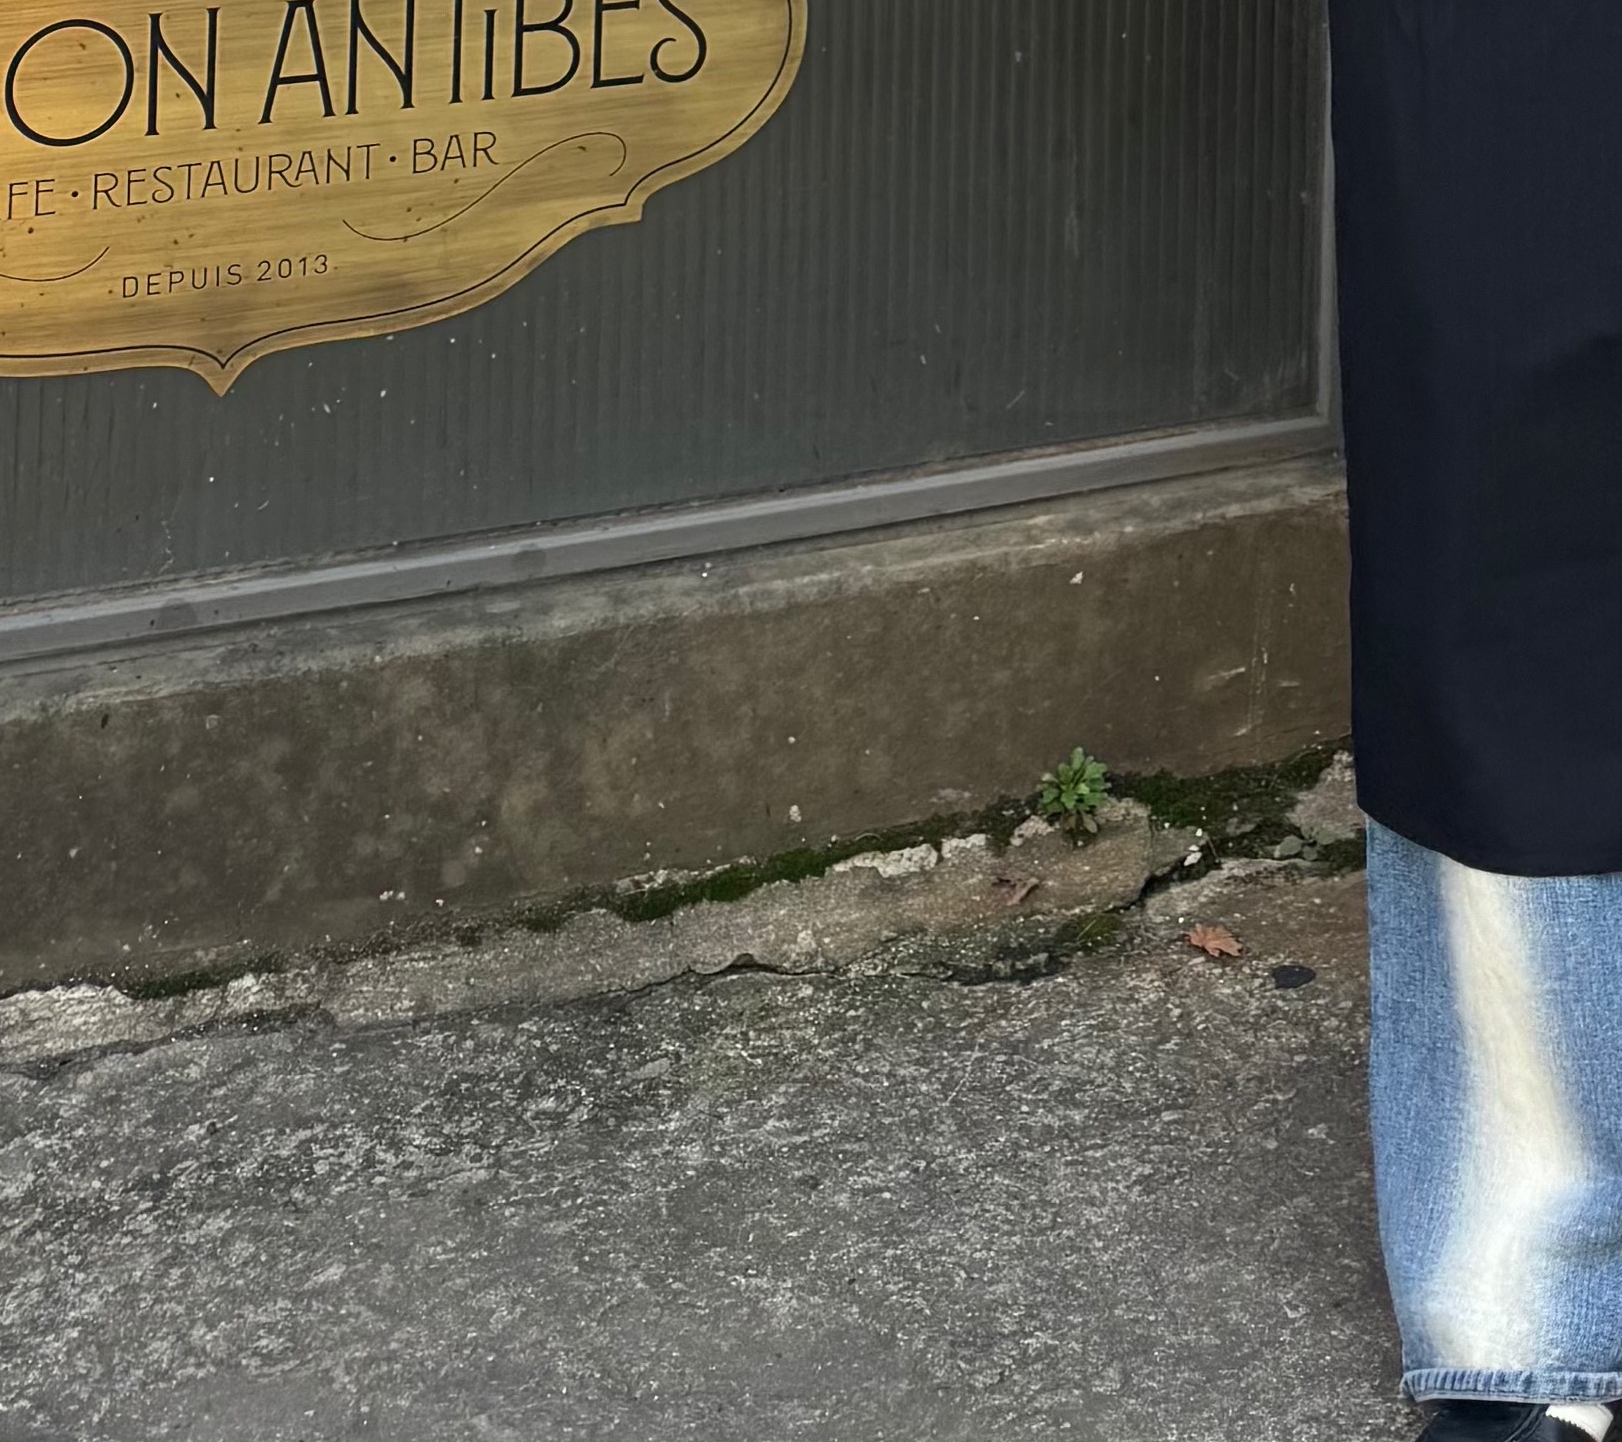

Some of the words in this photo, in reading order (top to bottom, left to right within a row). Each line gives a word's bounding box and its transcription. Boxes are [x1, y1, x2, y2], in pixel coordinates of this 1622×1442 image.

[3, 8, 220, 148] ON
[92, 144, 381, 211] RESTAURANT
[412, 131, 500, 175] BAR
[123, 262, 243, 300] DEPUIS
[256, 254, 329, 285] 2013
